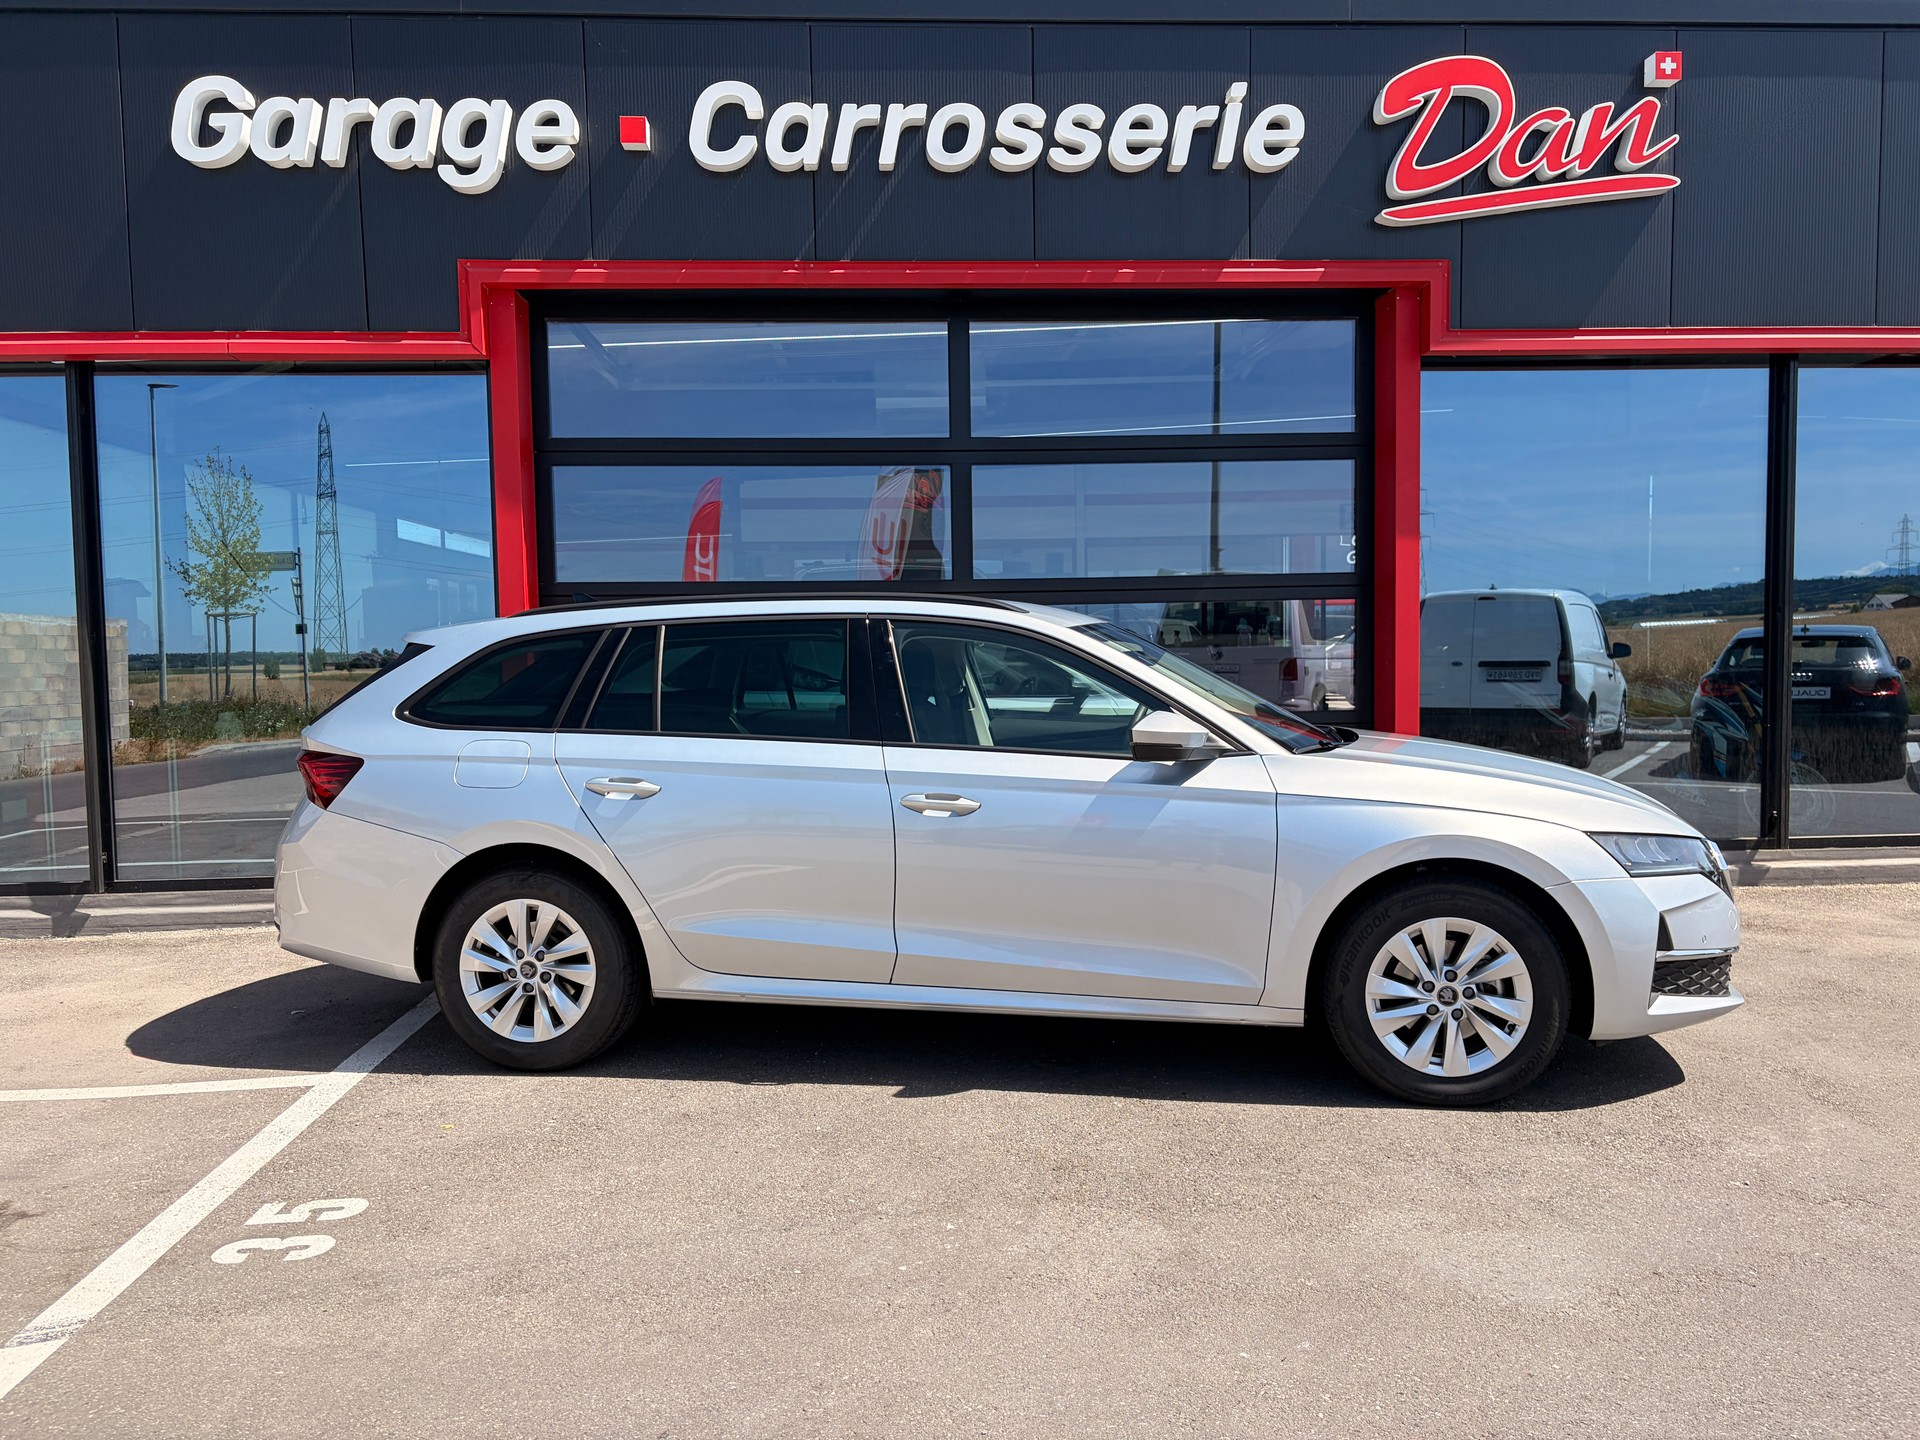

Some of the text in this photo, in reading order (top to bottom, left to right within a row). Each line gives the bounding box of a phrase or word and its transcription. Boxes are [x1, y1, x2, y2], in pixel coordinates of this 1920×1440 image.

[170, 74, 1306, 196] Garage Carrosserie
[210, 1197, 370, 1265] 35
